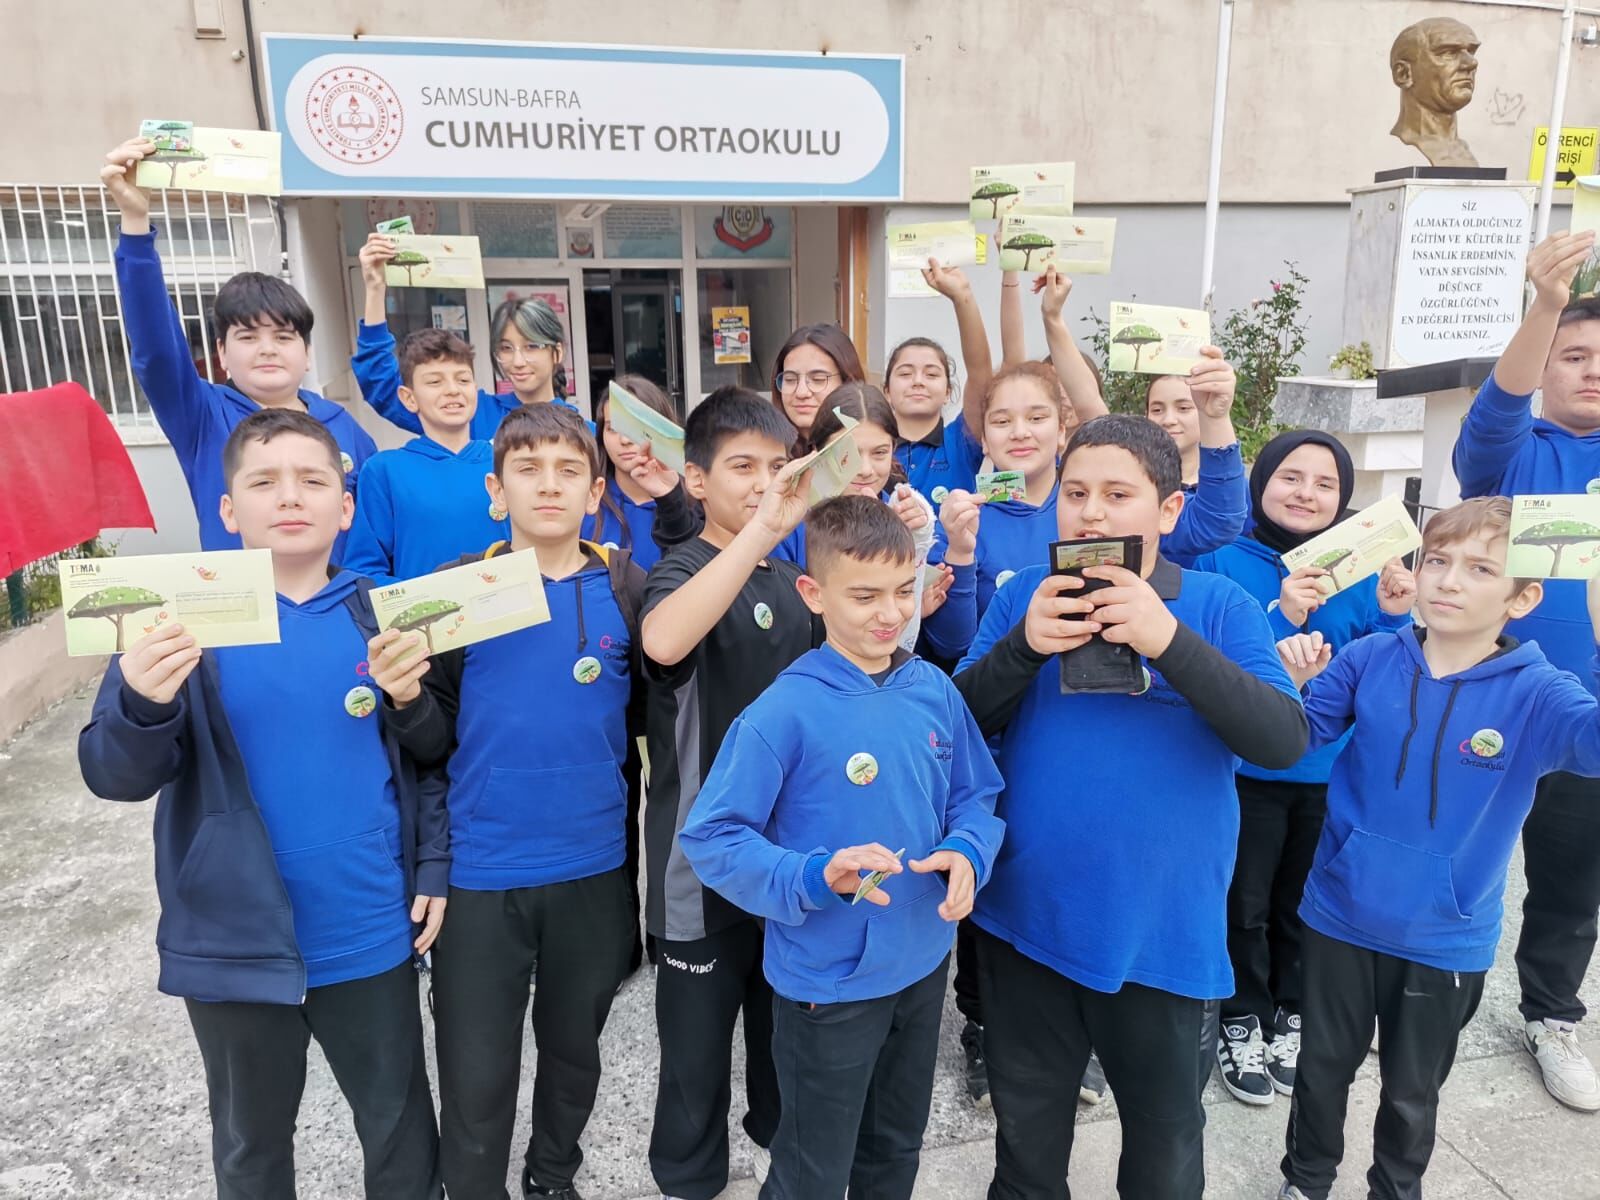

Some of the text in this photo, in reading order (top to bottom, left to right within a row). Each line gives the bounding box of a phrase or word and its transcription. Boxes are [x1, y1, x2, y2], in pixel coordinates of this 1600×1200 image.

[421, 86, 582, 109] SAMSUN-BAFRA
[425, 117, 841, 156] CUMHURİYET ORTAOKULU
[1537, 131, 1594, 148] ÖRENCİ
[1461, 200, 1477, 211] SİZ
[1414, 216, 1523, 228] ALMAKTA OLDUĞUNUZ
[1410, 232, 1522, 244] EĞİTİM VE KÜLTÜR İLE
[1412, 249, 1517, 261] İNSANLIK ERDEMİNİN,
[1419, 267, 1449, 276] VATAN
[1438, 281, 1482, 293] DÜŞÜNCE
[1420, 298, 1499, 309] ÖZGÜRLÜĞÜNÜN
[1401, 312, 1515, 325] EN DEĞERLİ TEMSİLCİSİ
[70, 564, 94, 574] TEMA
